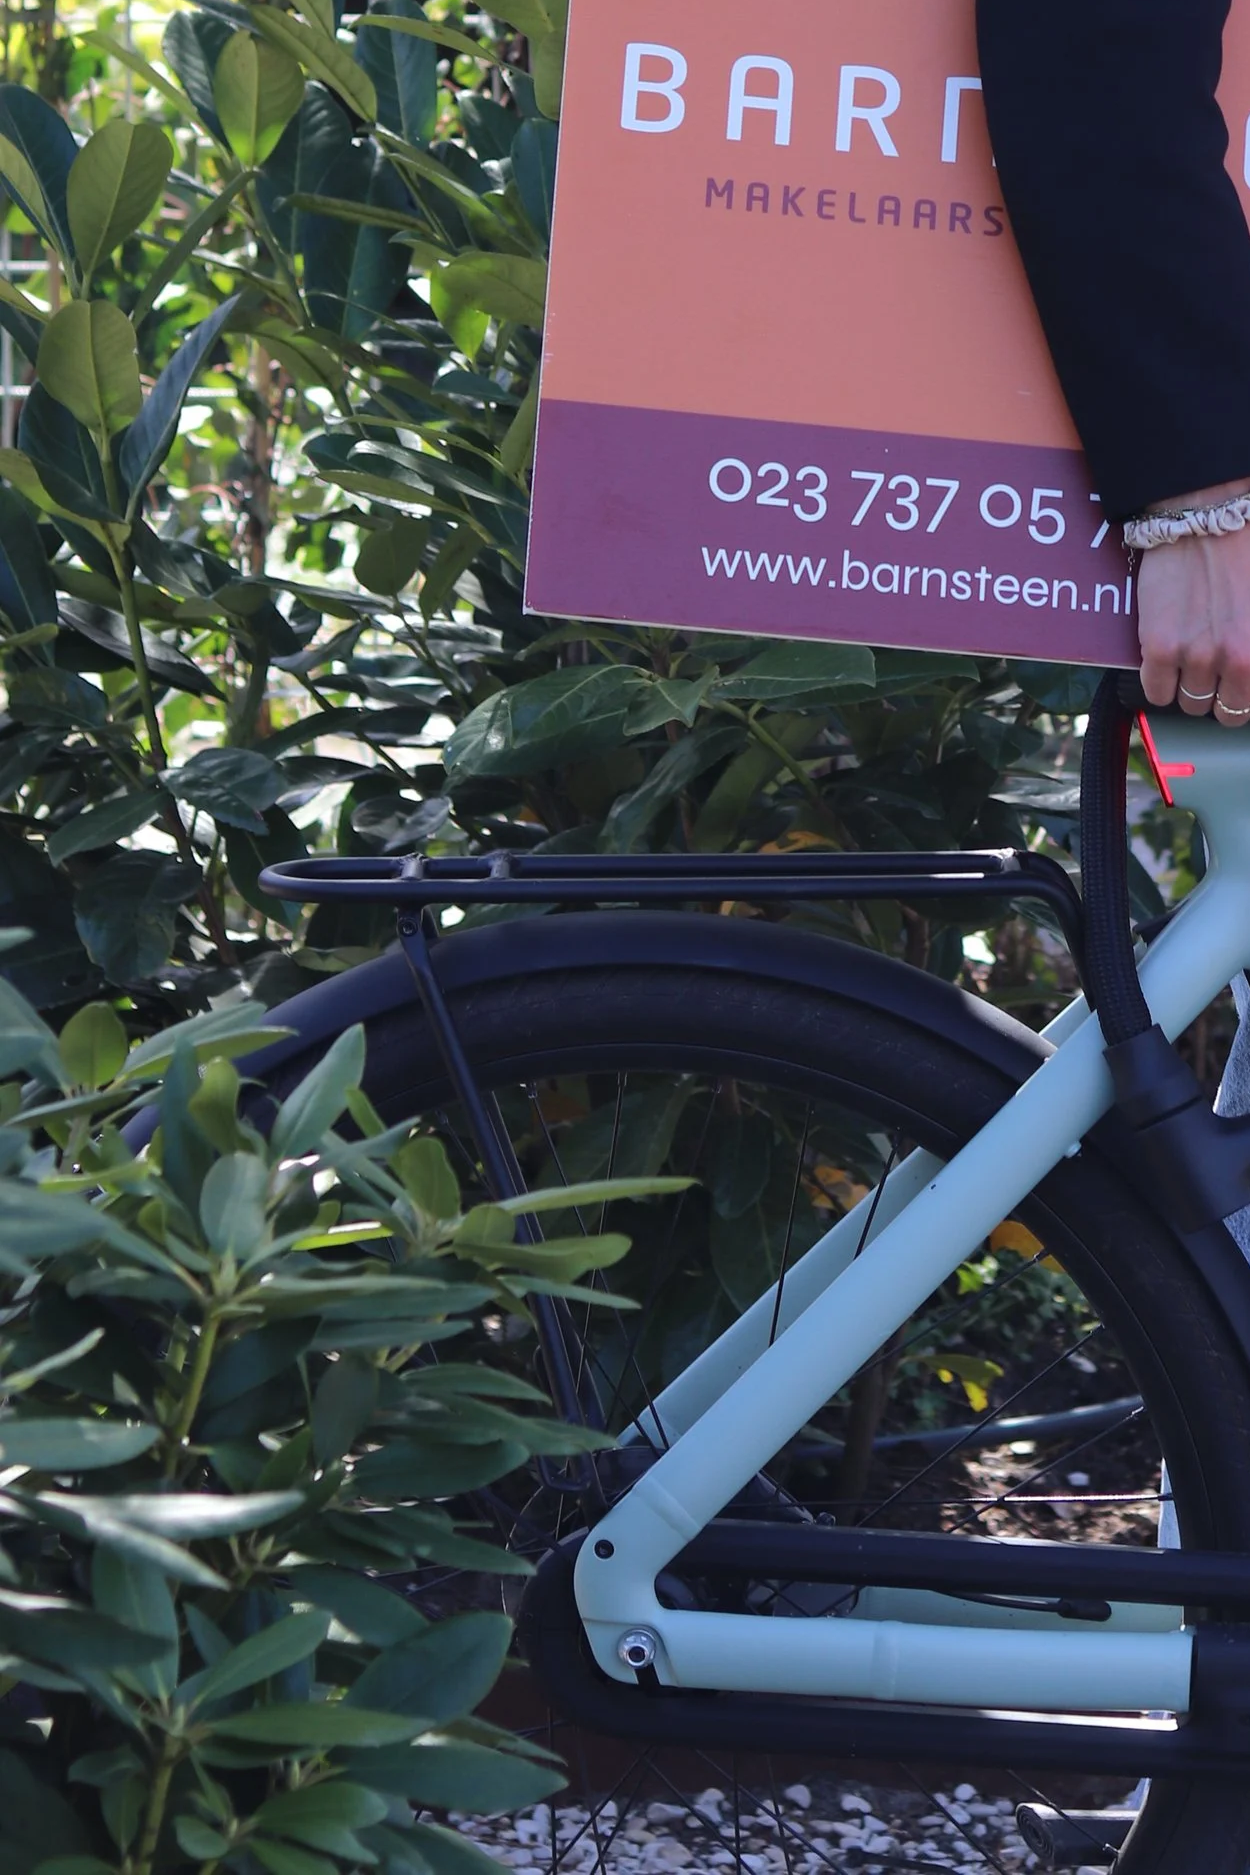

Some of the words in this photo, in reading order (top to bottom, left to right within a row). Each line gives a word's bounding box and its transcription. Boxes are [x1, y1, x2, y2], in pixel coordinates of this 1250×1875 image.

[704, 177, 1005, 237] MAKELAARS
[708, 457, 828, 522] 023
[850, 470, 960, 533] 737
[978, 483, 1067, 545] 05
[701, 547, 1133, 616] www.barnsteen.nl
